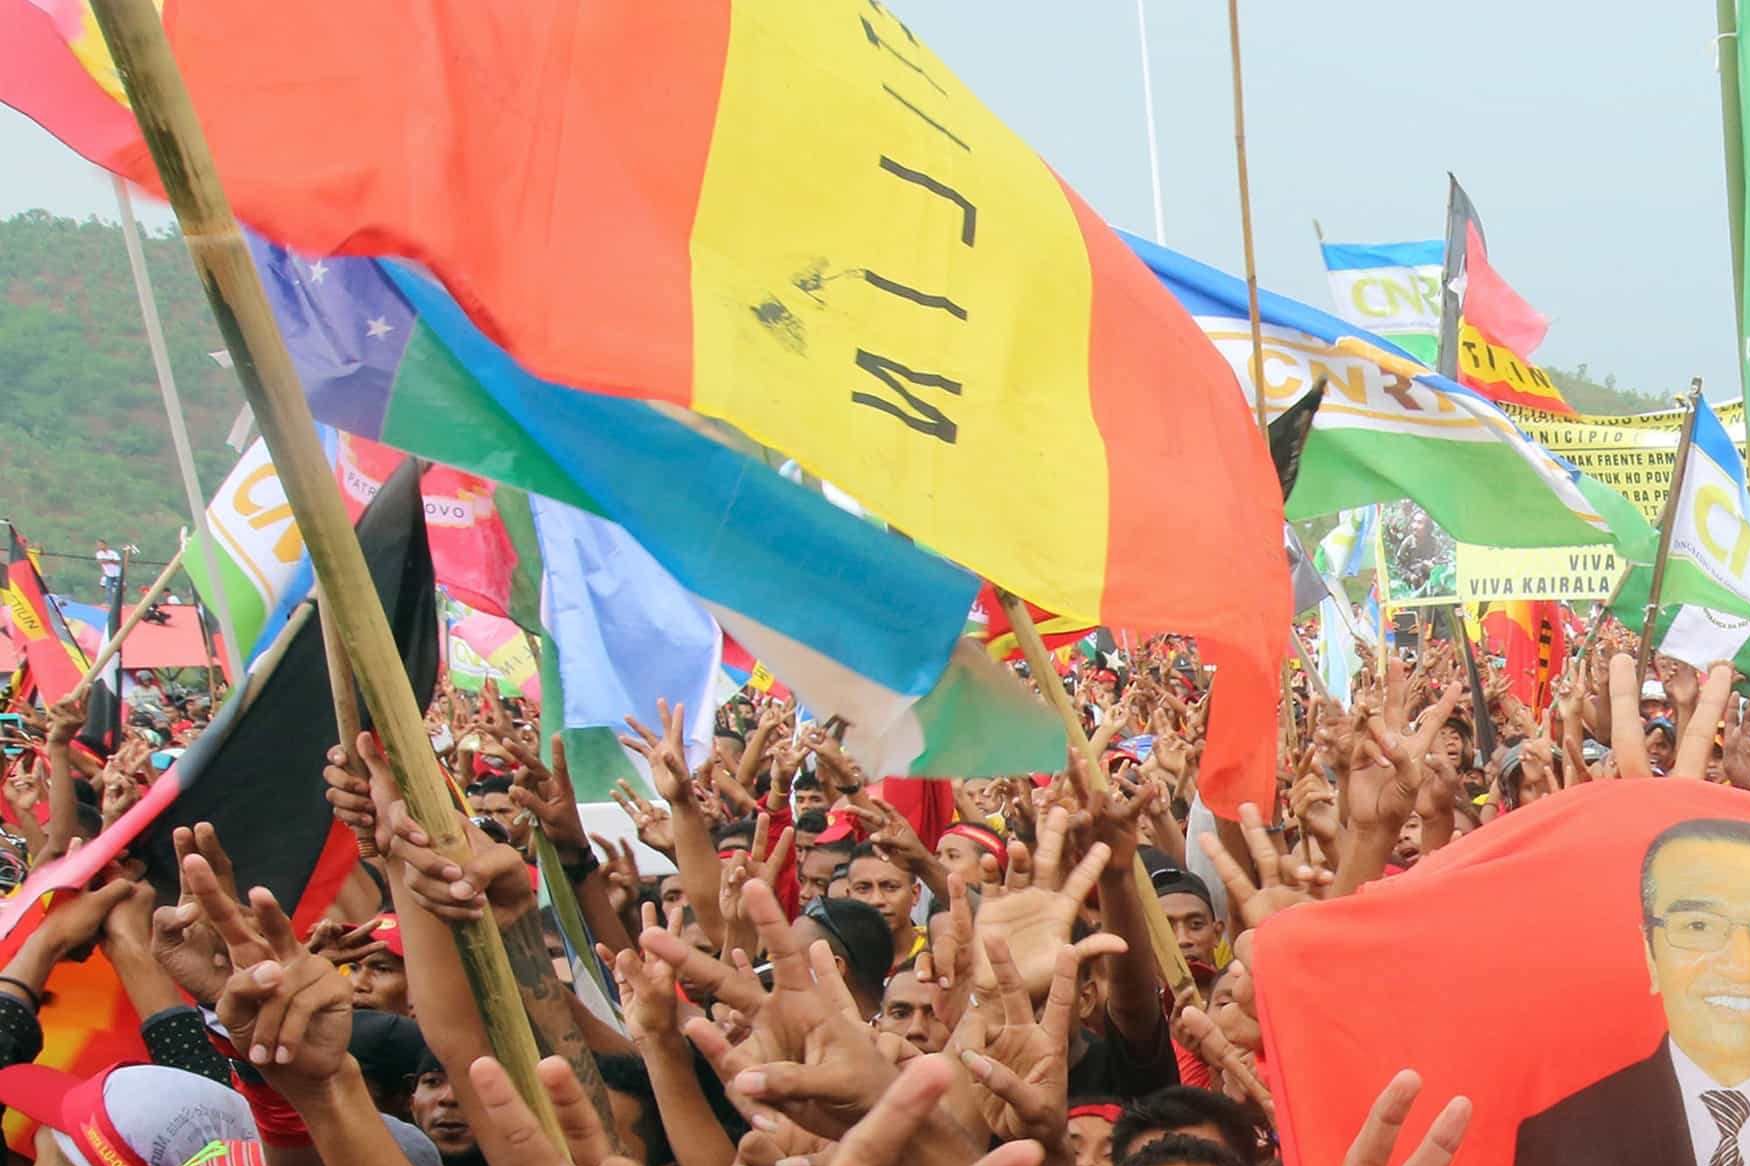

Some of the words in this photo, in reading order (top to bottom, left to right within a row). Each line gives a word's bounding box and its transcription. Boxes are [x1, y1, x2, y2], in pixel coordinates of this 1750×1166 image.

[1599, 453, 1643, 466] FRENTE
[1569, 553, 1616, 572] VIVA
[1469, 577, 1514, 596] VIVA
[1522, 575, 1611, 594] KAIRALA
